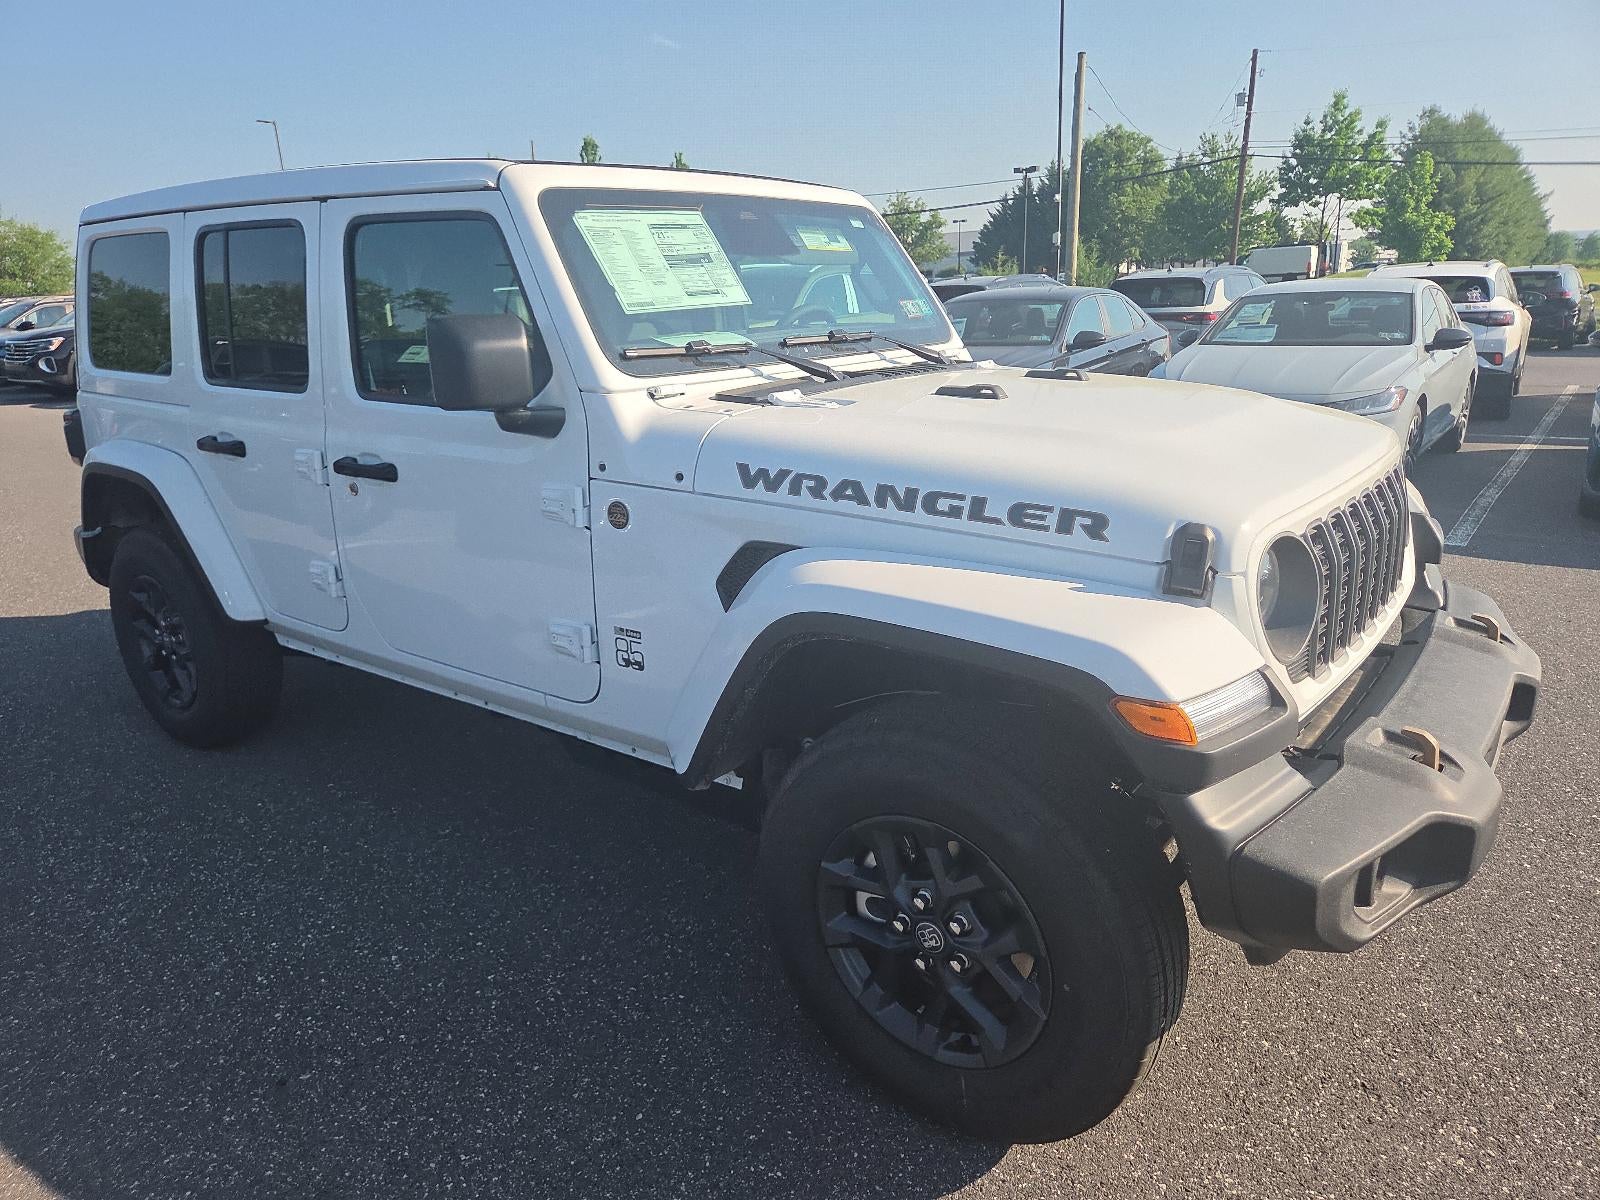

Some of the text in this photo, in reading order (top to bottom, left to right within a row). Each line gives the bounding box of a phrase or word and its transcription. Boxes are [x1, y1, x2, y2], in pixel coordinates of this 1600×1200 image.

[736, 462, 1110, 542] WRANGLER
[615, 637, 645, 671] 85
[918, 928, 940, 947] 85
